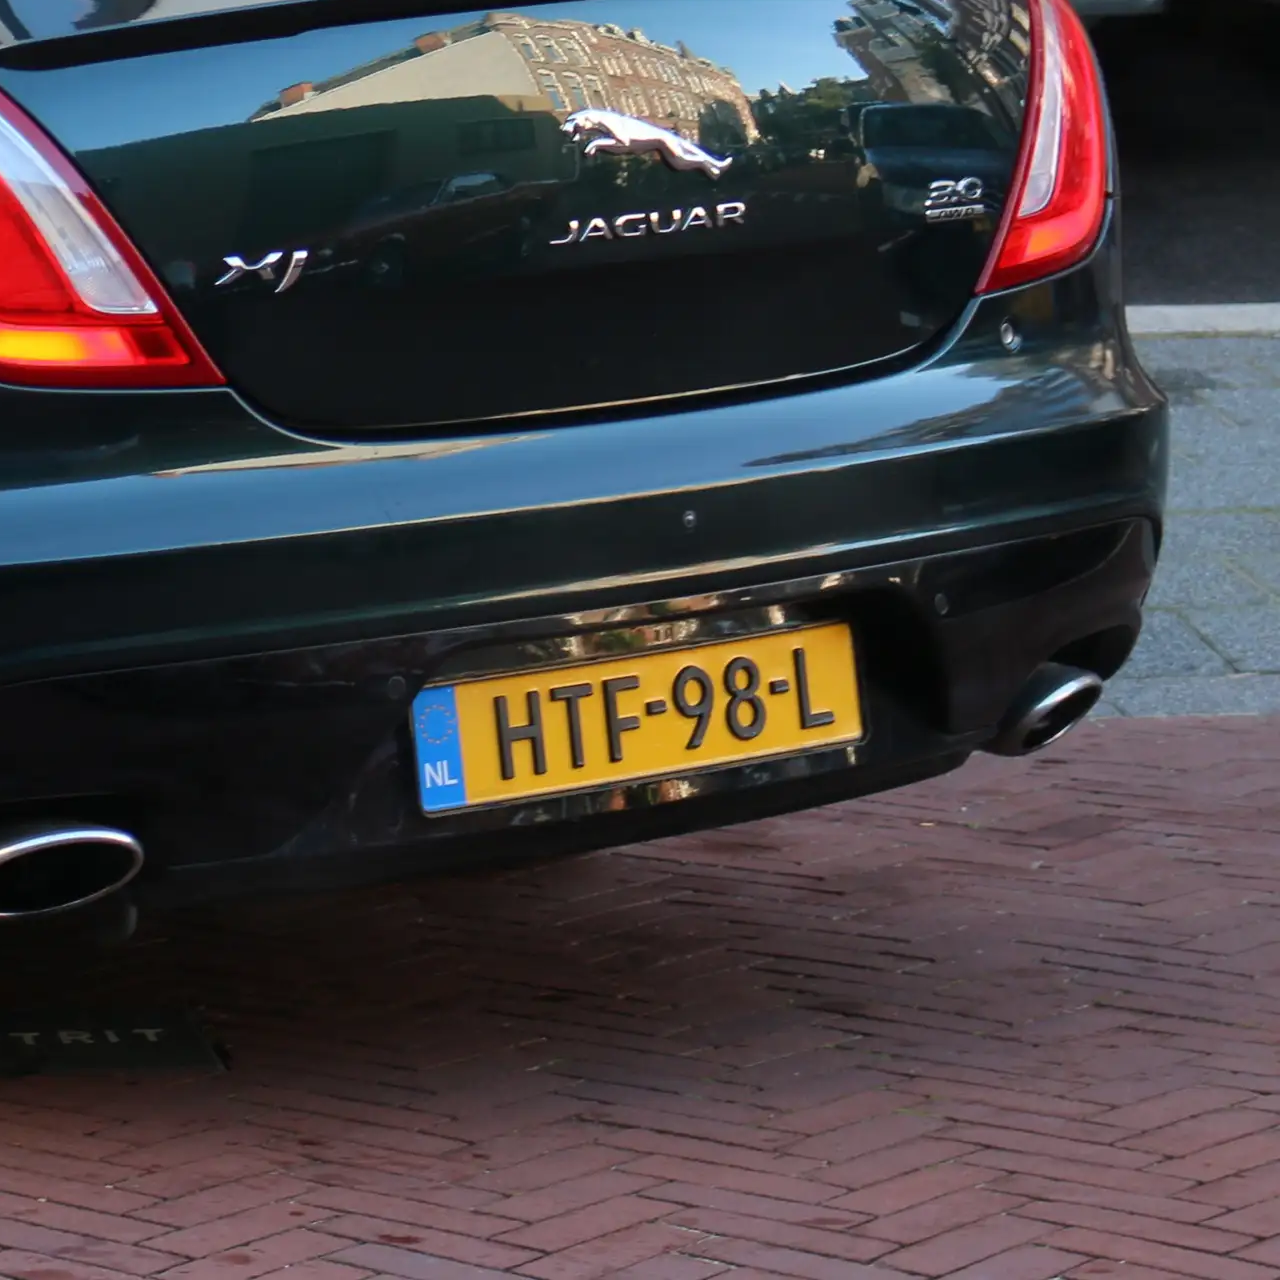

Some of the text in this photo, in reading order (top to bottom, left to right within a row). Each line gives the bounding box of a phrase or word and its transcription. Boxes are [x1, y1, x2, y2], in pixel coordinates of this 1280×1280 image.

[549, 201, 747, 245] JAGUAR
[214, 250, 309, 293] XJ
[493, 646, 835, 780] HTF-98-L
[424, 760, 458, 789] NL
